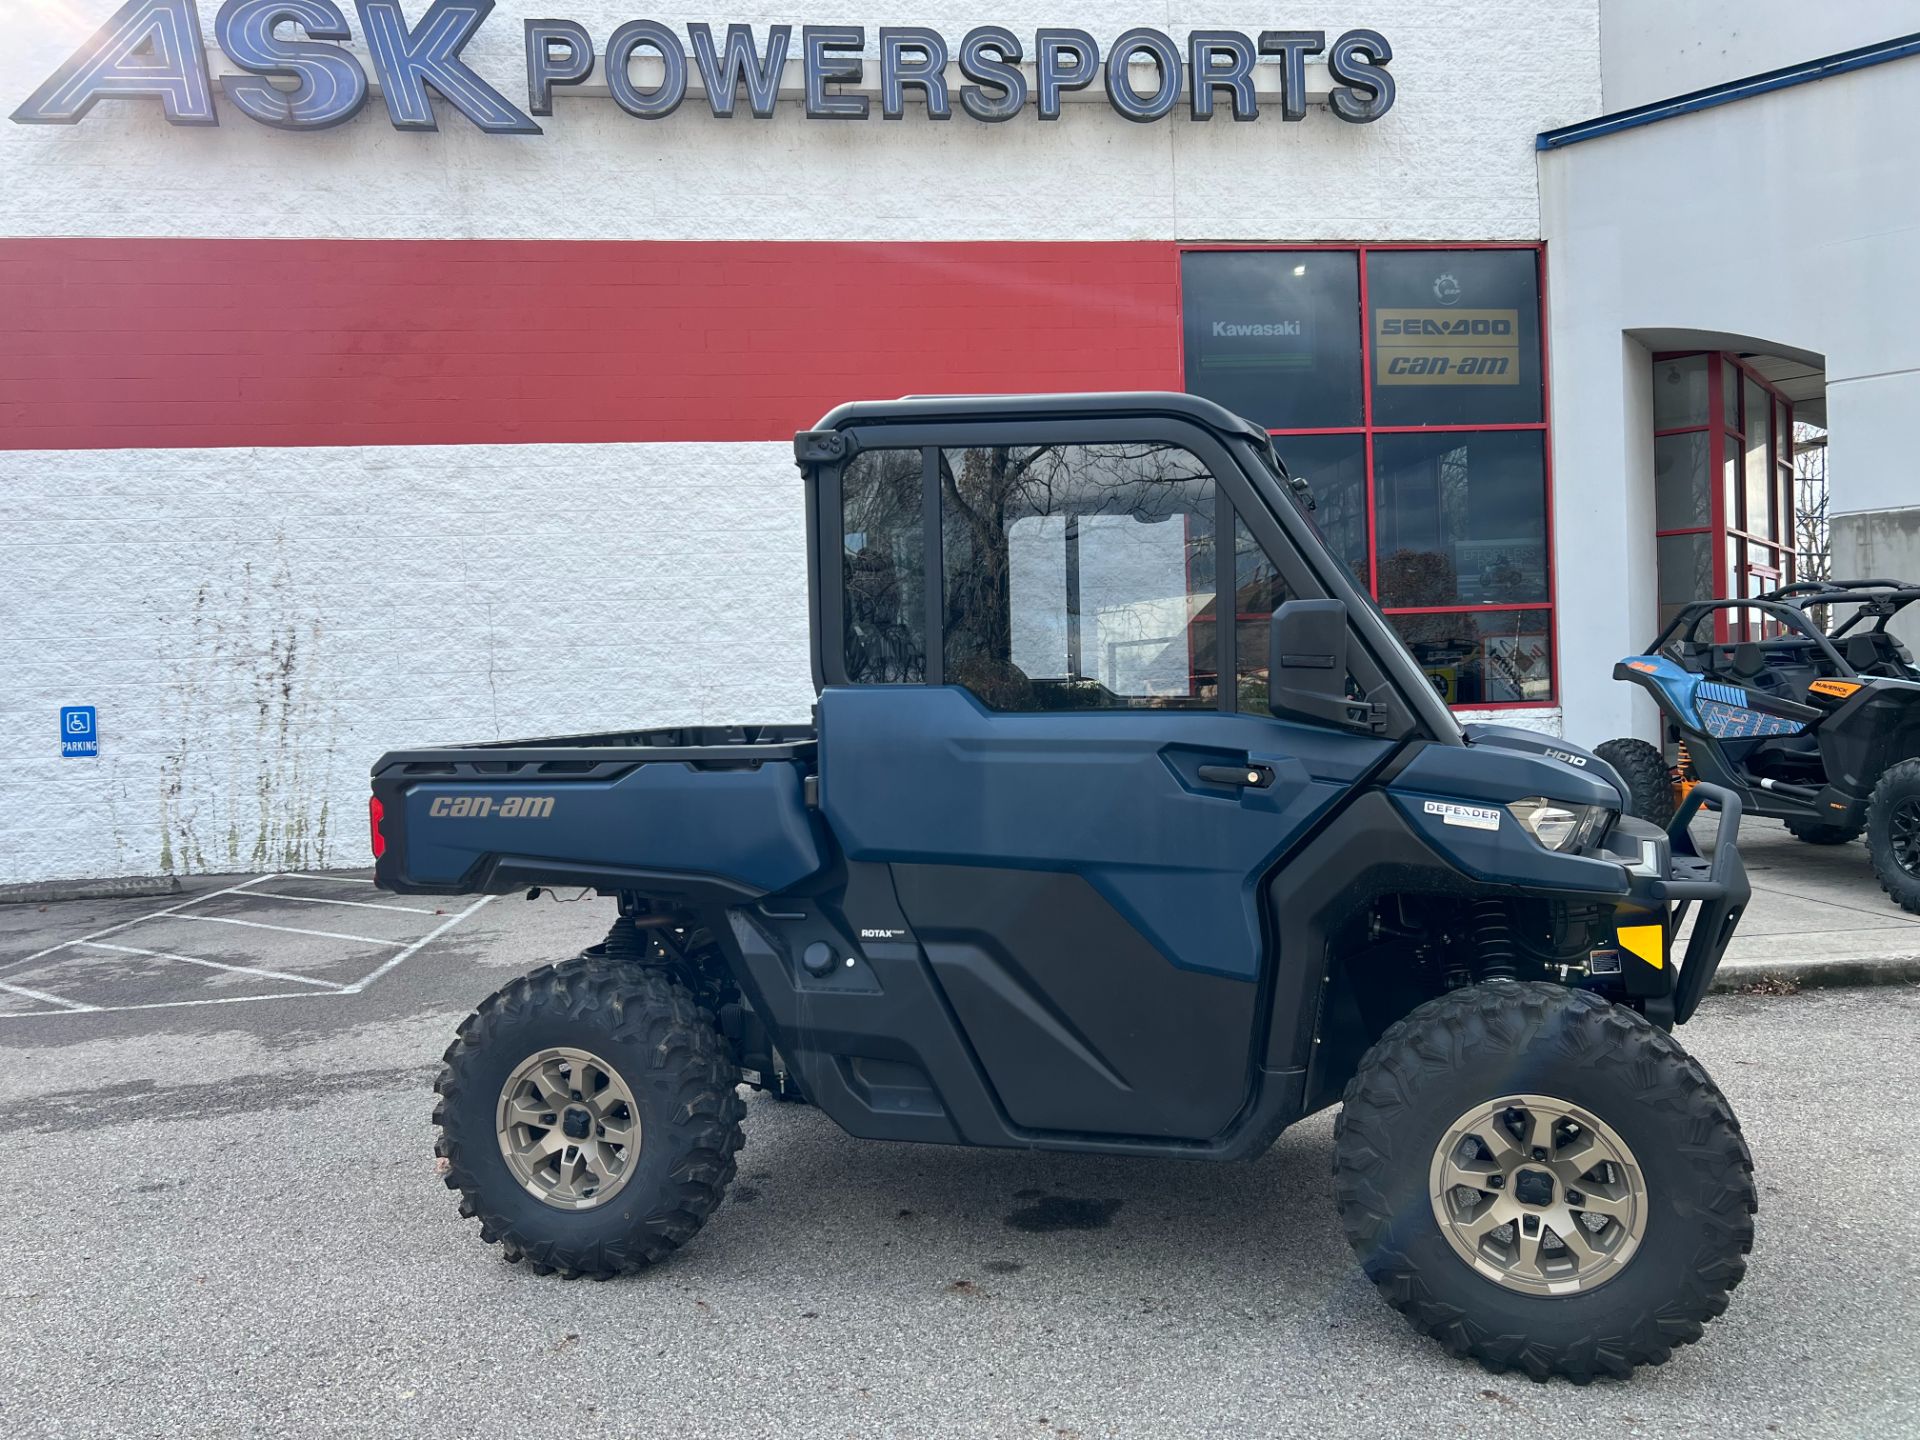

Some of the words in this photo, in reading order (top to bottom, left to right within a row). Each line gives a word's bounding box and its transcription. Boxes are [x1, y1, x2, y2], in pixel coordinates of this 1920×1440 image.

[9, 0, 545, 136] ASK
[524, 18, 1396, 124] POWERSPORTS
[1212, 320, 1301, 337] Kawasaki
[1387, 356, 1509, 375] can-am
[61, 741, 97, 752] PARKING
[1544, 748, 1587, 767] HD10
[429, 796, 556, 818] can-am
[1426, 803, 1499, 820] DEFENDER
[861, 929, 893, 938] ROTAX
